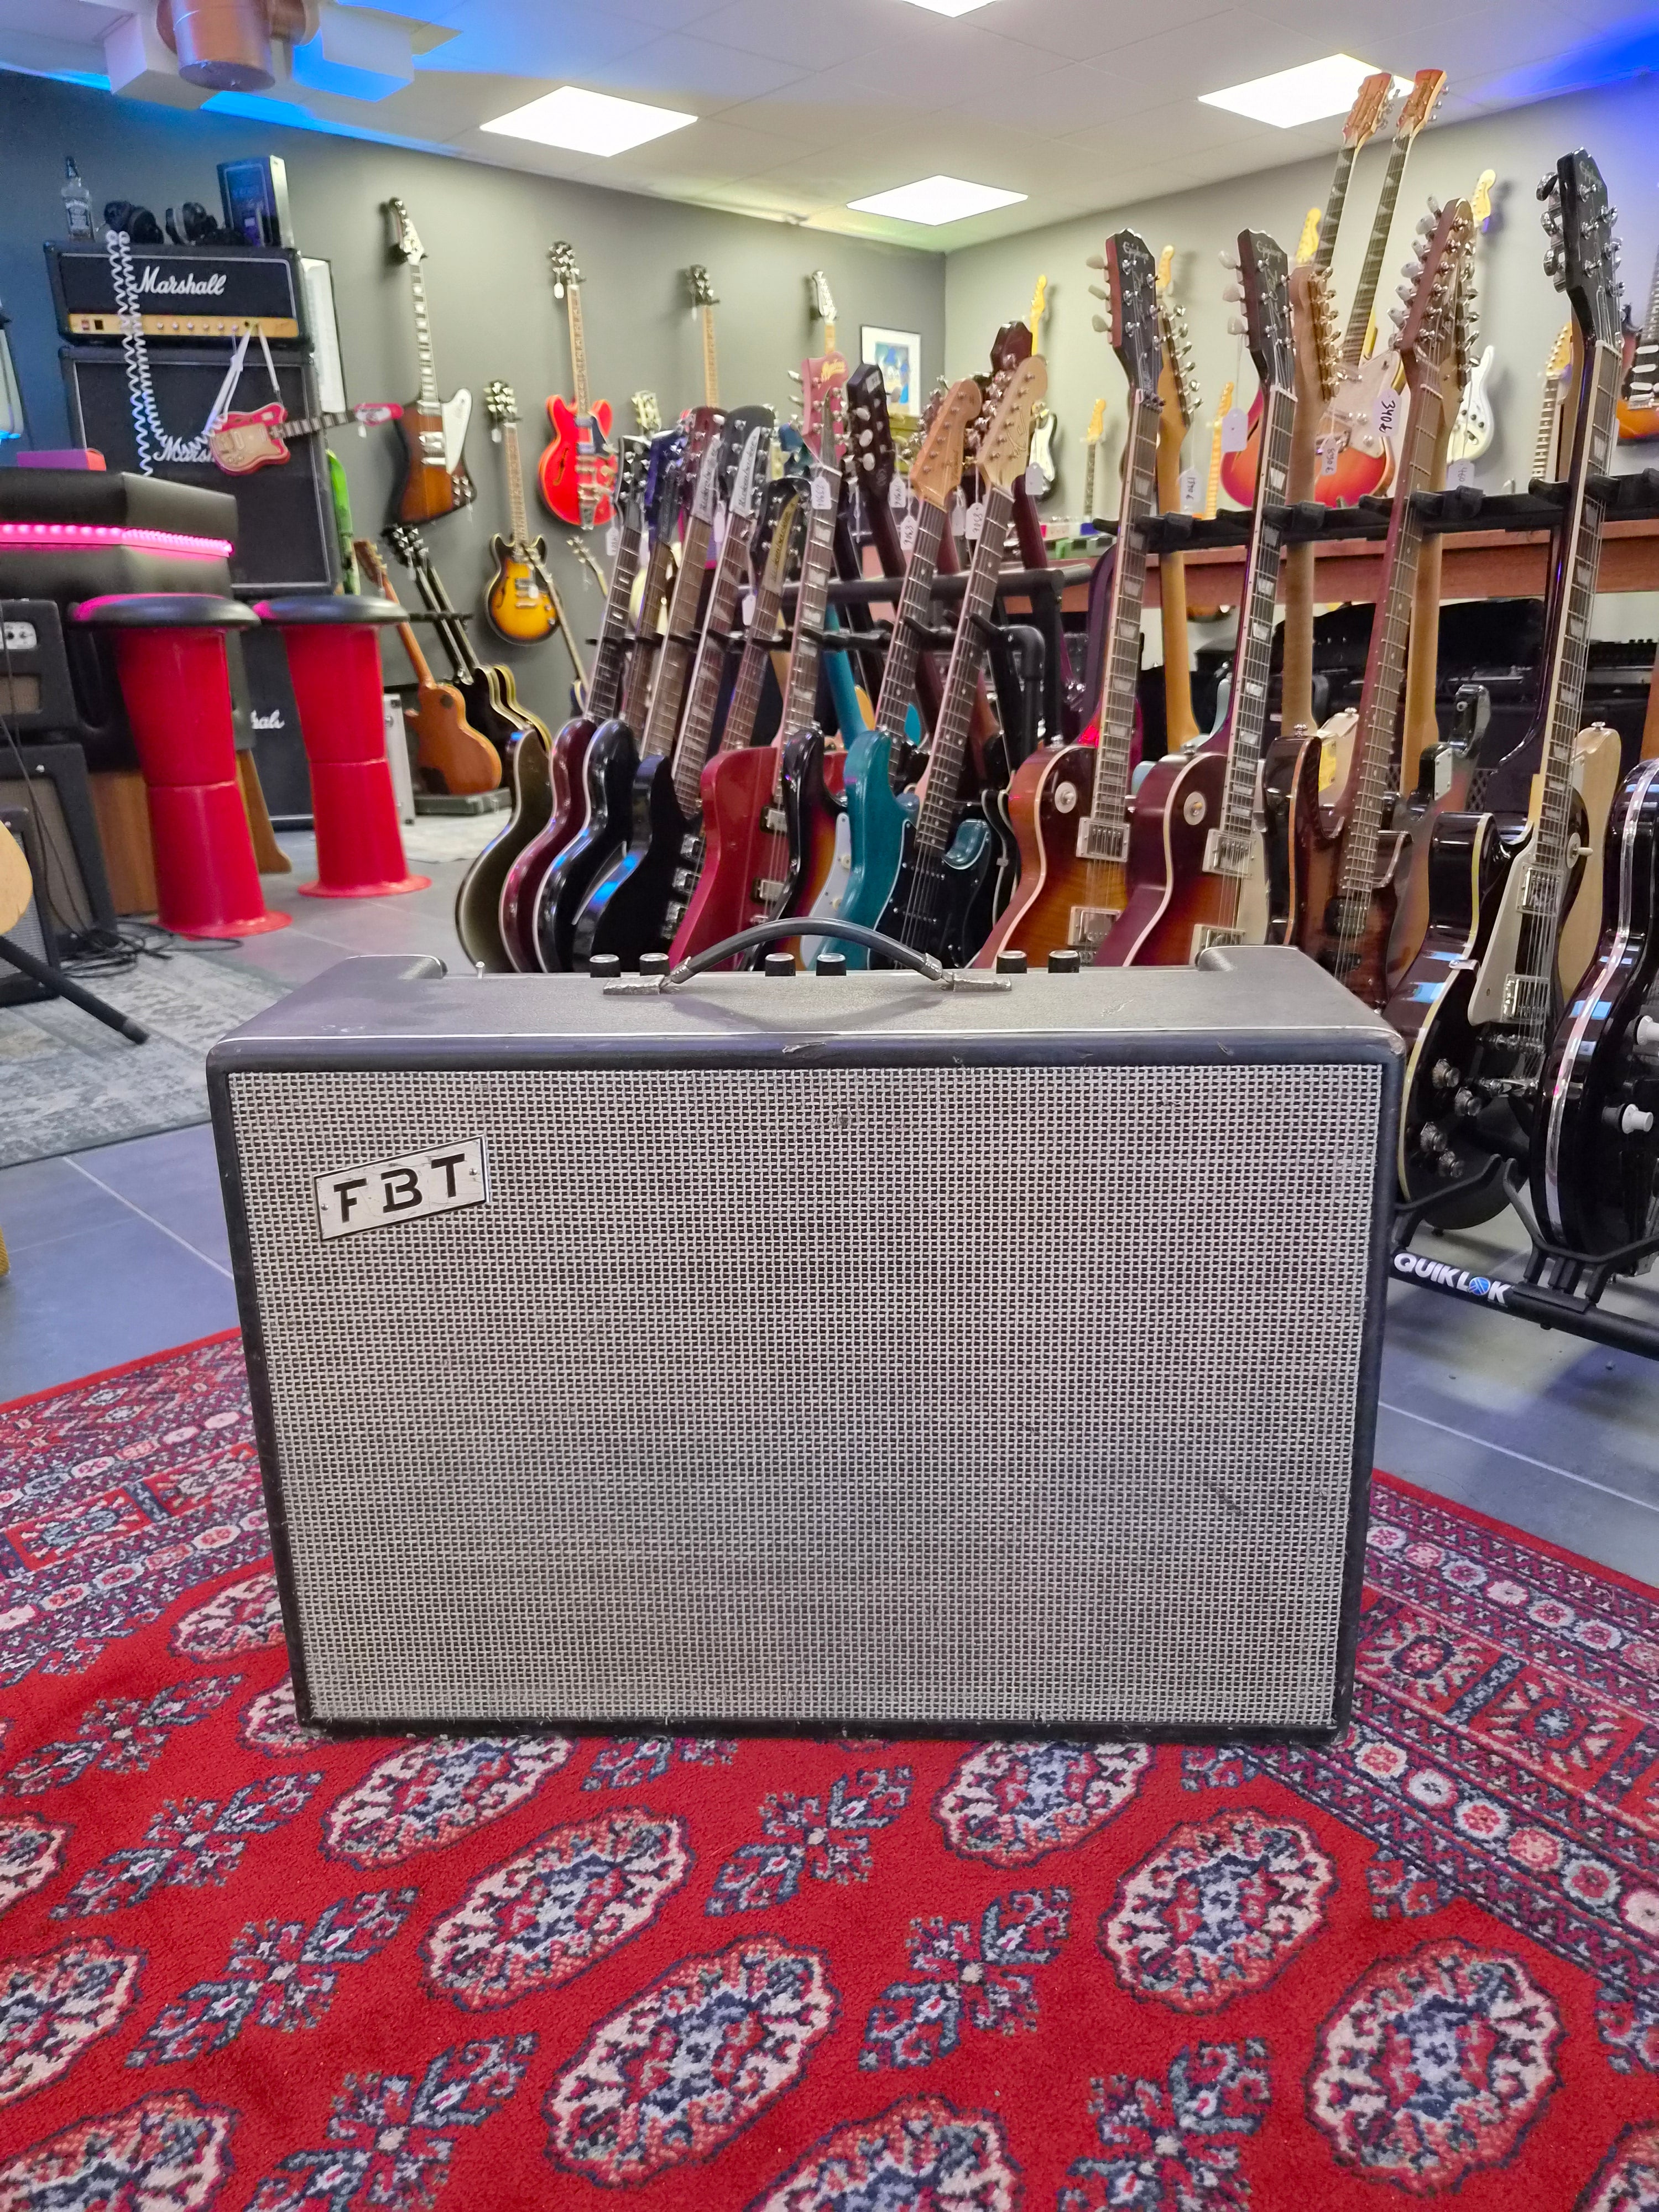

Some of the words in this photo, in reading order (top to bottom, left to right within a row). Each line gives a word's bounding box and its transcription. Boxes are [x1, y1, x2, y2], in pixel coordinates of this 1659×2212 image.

[134, 265, 227, 295] Marshall
[152, 436, 215, 463] Mars
[333, 1153, 465, 1223] FBT
